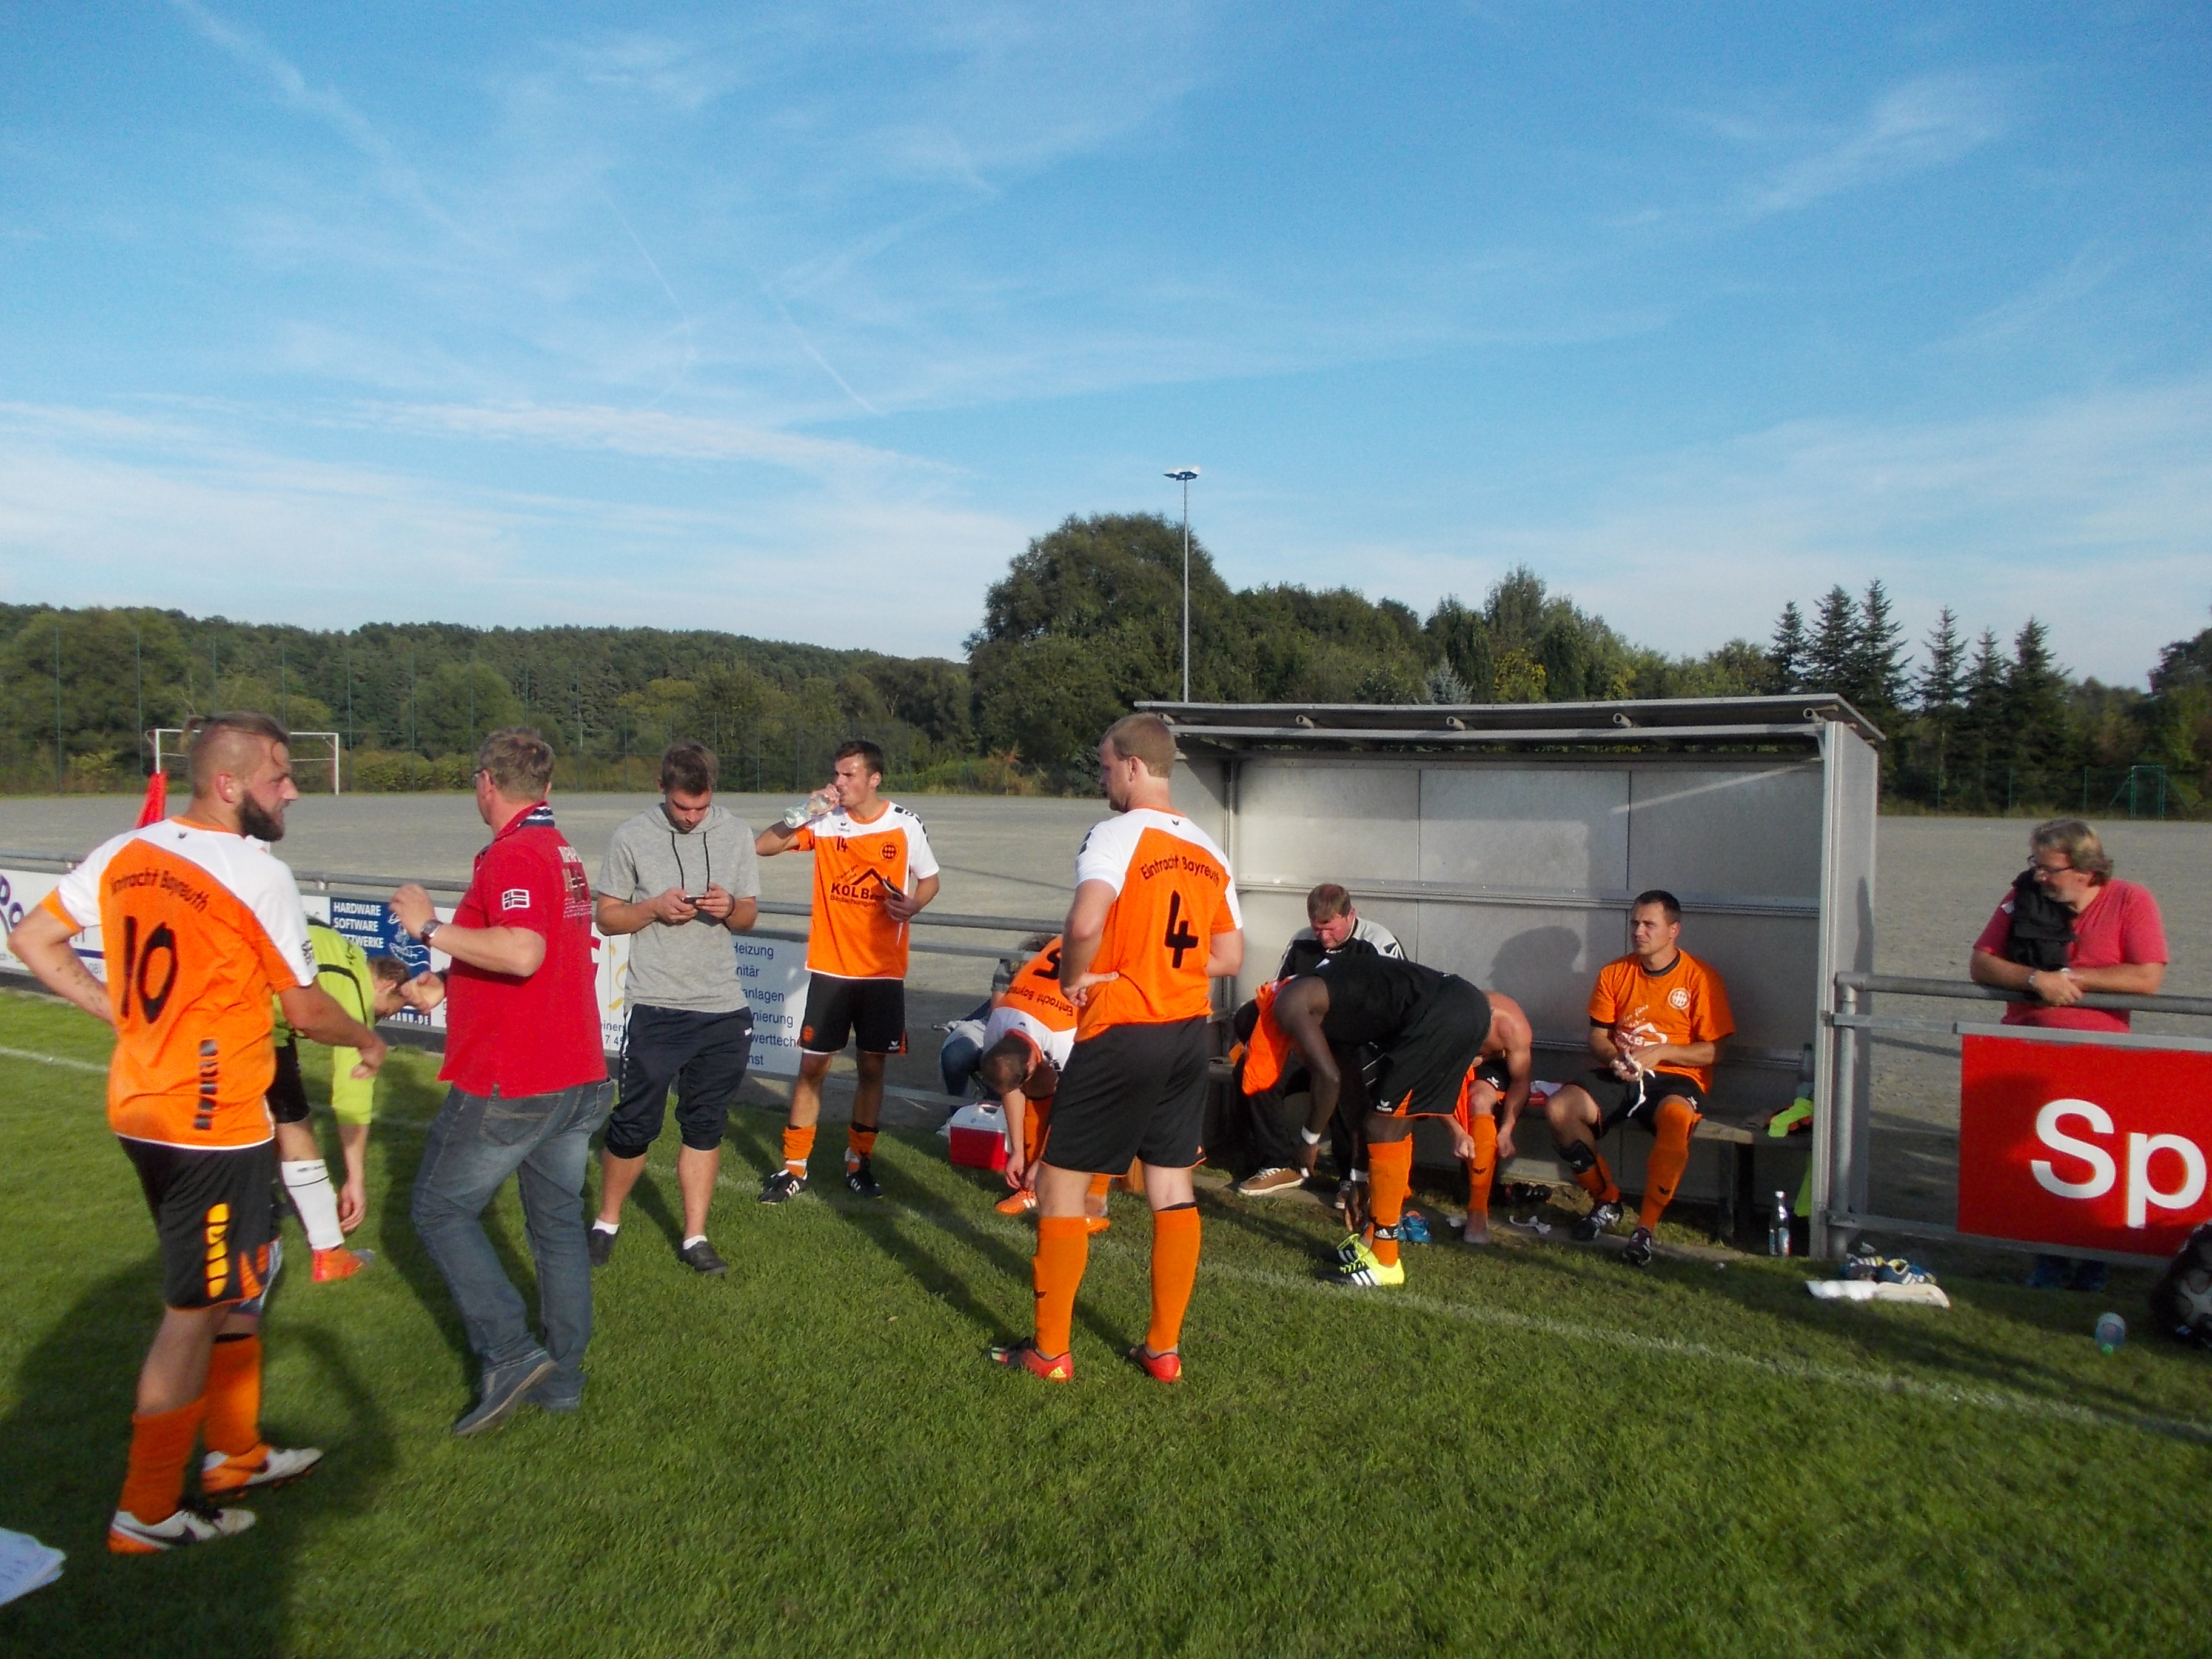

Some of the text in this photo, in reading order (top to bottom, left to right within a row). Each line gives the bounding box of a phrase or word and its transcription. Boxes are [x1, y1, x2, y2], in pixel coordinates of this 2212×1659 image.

[836, 836, 848, 853] 14
[1141, 856, 1219, 887] Eintracht Bayreuth
[333, 901, 381, 916] HARDWARE
[333, 917, 379, 933] SOFTWARE
[1164, 890, 1199, 969] 4
[120, 916, 179, 1025] 10
